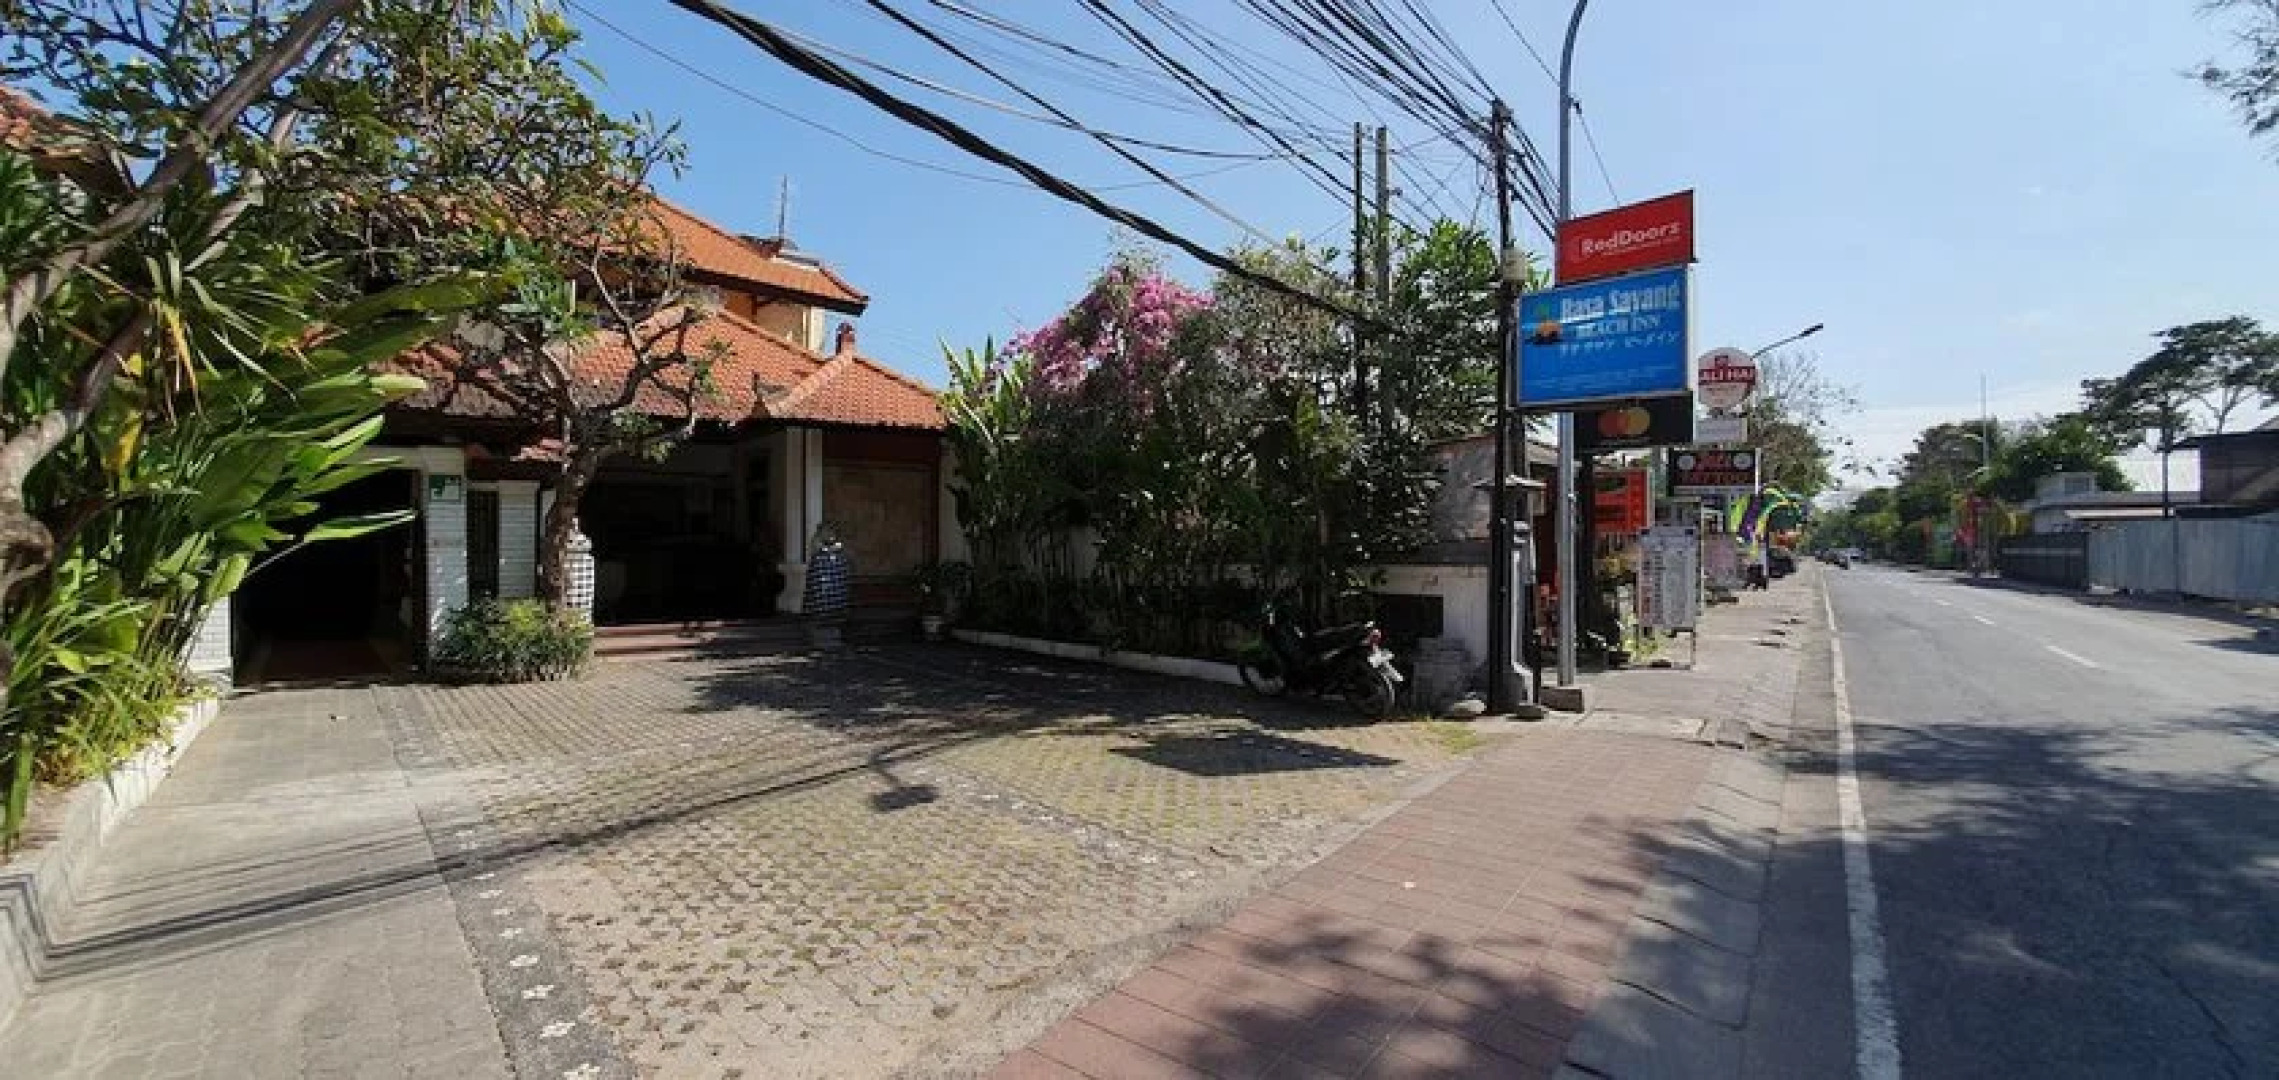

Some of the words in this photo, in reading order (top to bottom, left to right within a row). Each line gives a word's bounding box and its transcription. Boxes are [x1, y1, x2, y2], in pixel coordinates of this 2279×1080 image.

[1609, 281, 1680, 315] Sayang
[1576, 318, 1628, 338] BEACH
[1631, 313, 1661, 332] INN
